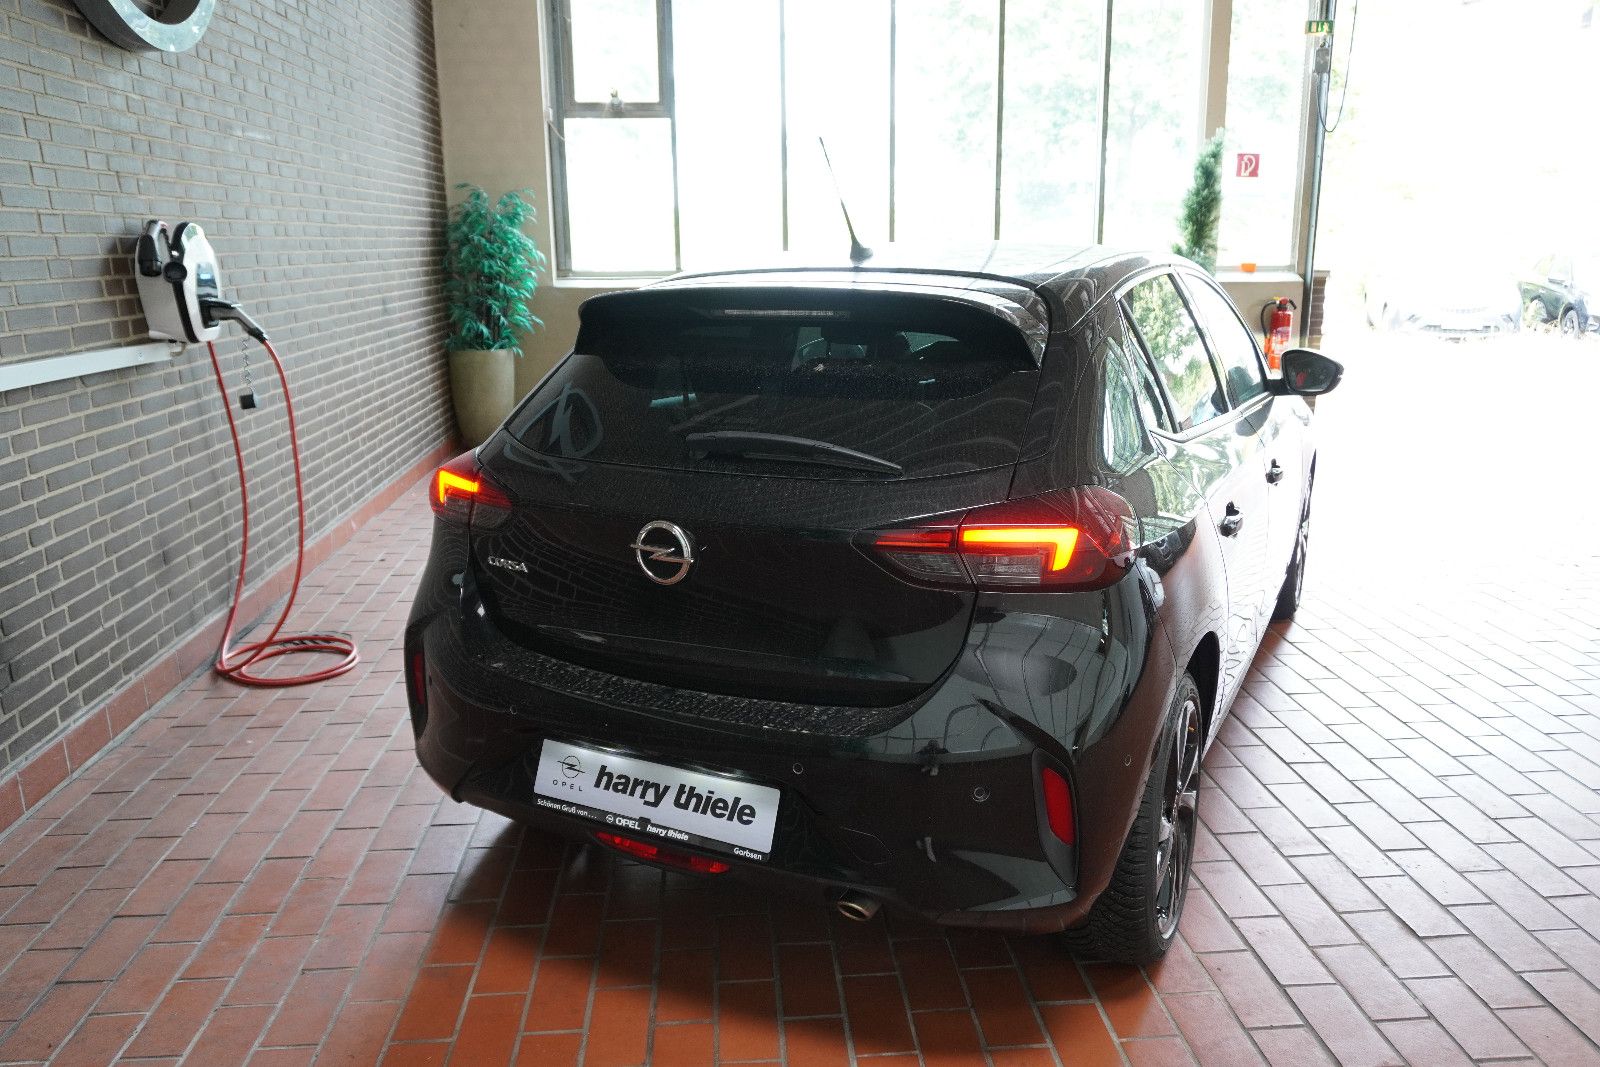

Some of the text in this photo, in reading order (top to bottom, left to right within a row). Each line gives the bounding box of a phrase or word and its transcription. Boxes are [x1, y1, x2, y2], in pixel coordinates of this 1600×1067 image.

[552, 779, 583, 792] OPEL
[593, 764, 756, 825] harry thiele
[615, 817, 641, 830] OPEL
[646, 824, 667, 837] harry
[733, 847, 762, 861] Garbsen
